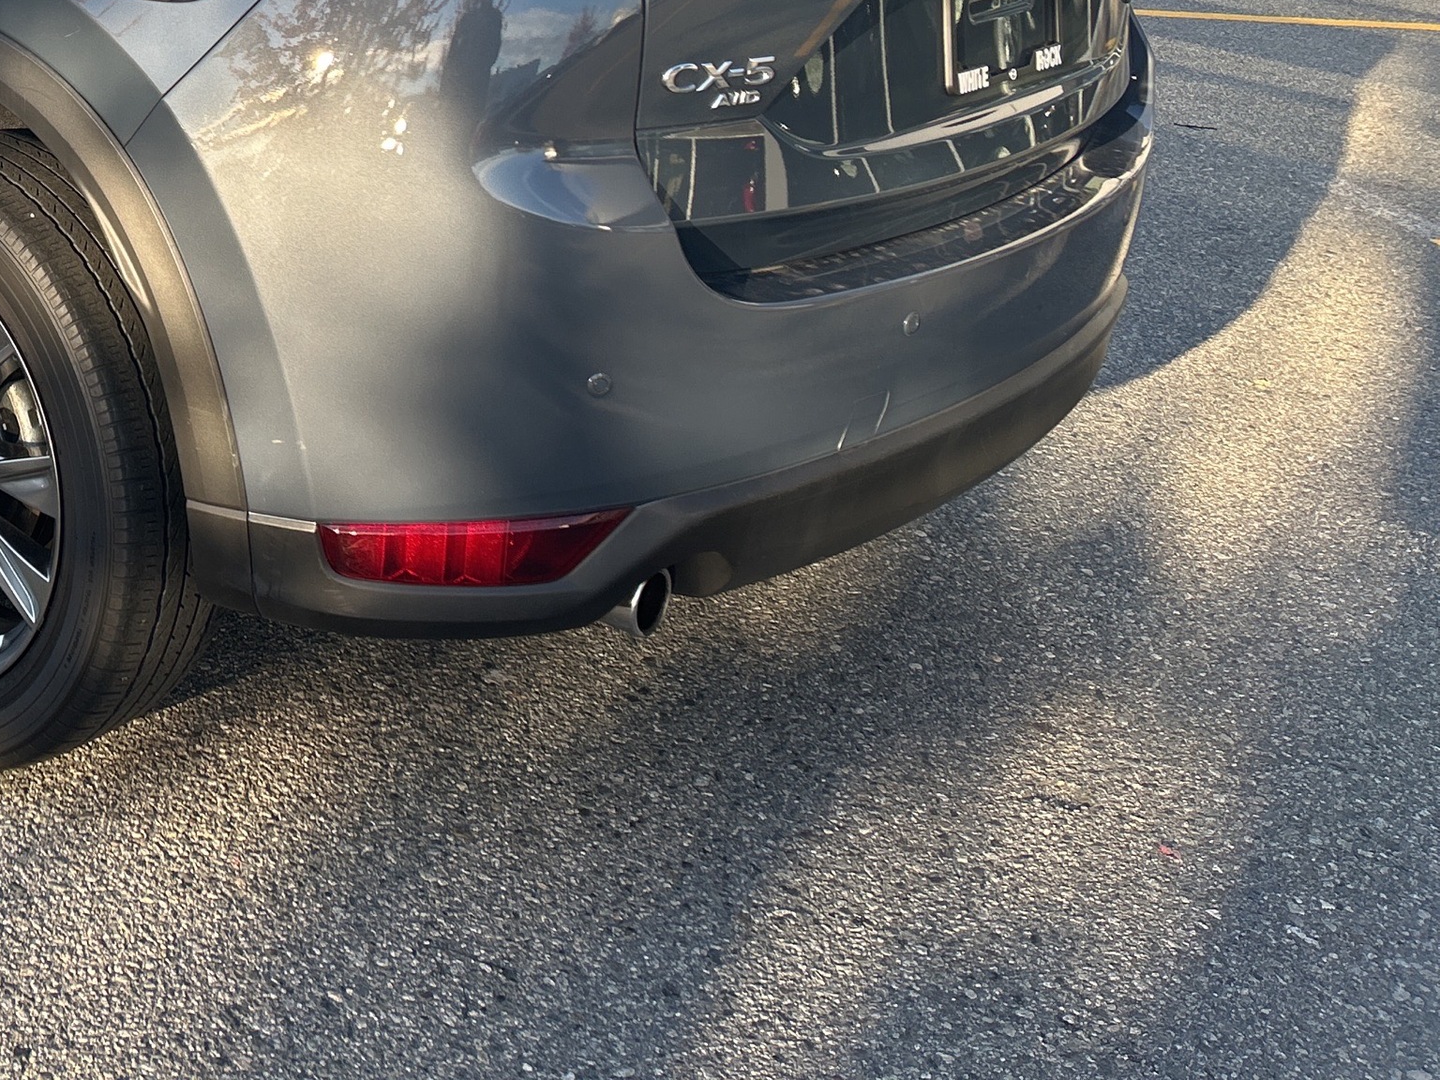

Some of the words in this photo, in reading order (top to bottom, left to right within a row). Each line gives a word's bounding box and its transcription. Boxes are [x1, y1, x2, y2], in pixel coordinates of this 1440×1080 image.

[661, 55, 776, 94] CX-5
[957, 65, 990, 95] WHITE
[1035, 44, 1063, 72] ROCK
[710, 89, 761, 109] AWD
